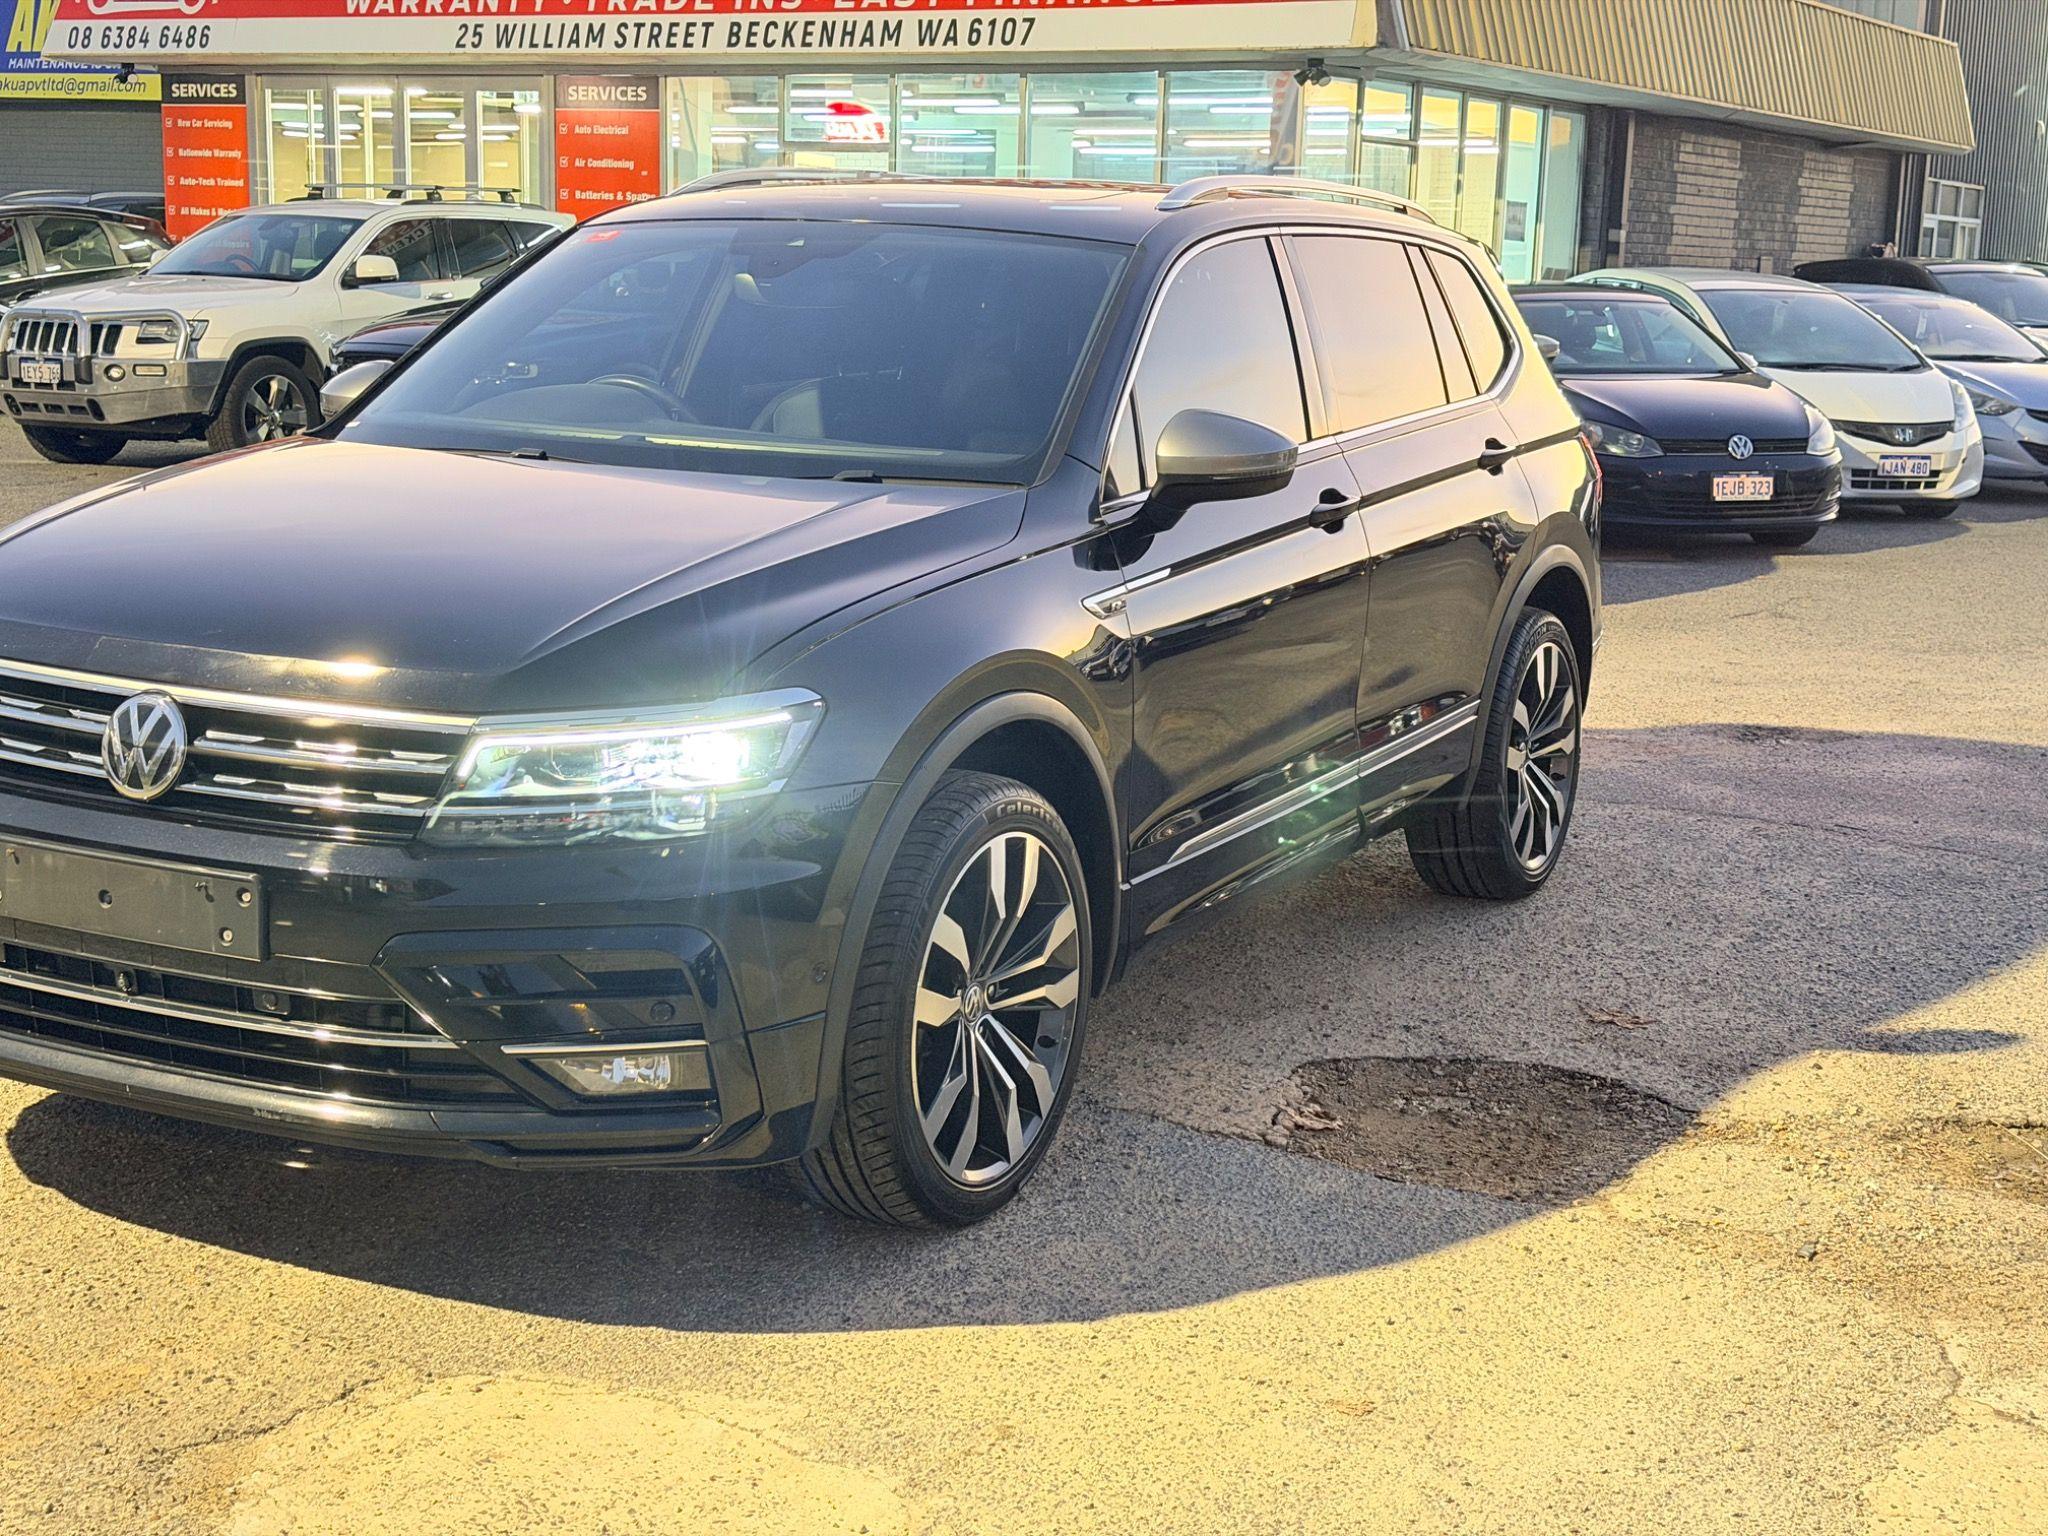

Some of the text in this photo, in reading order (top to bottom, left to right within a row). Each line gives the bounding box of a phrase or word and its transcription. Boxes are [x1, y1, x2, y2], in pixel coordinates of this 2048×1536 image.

[67, 24, 211, 49] 08 6384 6486
[455, 17, 1036, 49] 25 WILLIAM STREET BECKENHAM WA 6107
[171, 83, 238, 98] SERVICES
[567, 85, 648, 102] SERVICES
[203, 119, 234, 130] Servicing
[574, 124, 630, 136] Auto Electrical
[574, 157, 635, 171] Air Conditioning
[179, 176, 245, 188] Auto-Tech Trained
[574, 189, 615, 201] Batteries
[616, 191, 624, 201] &
